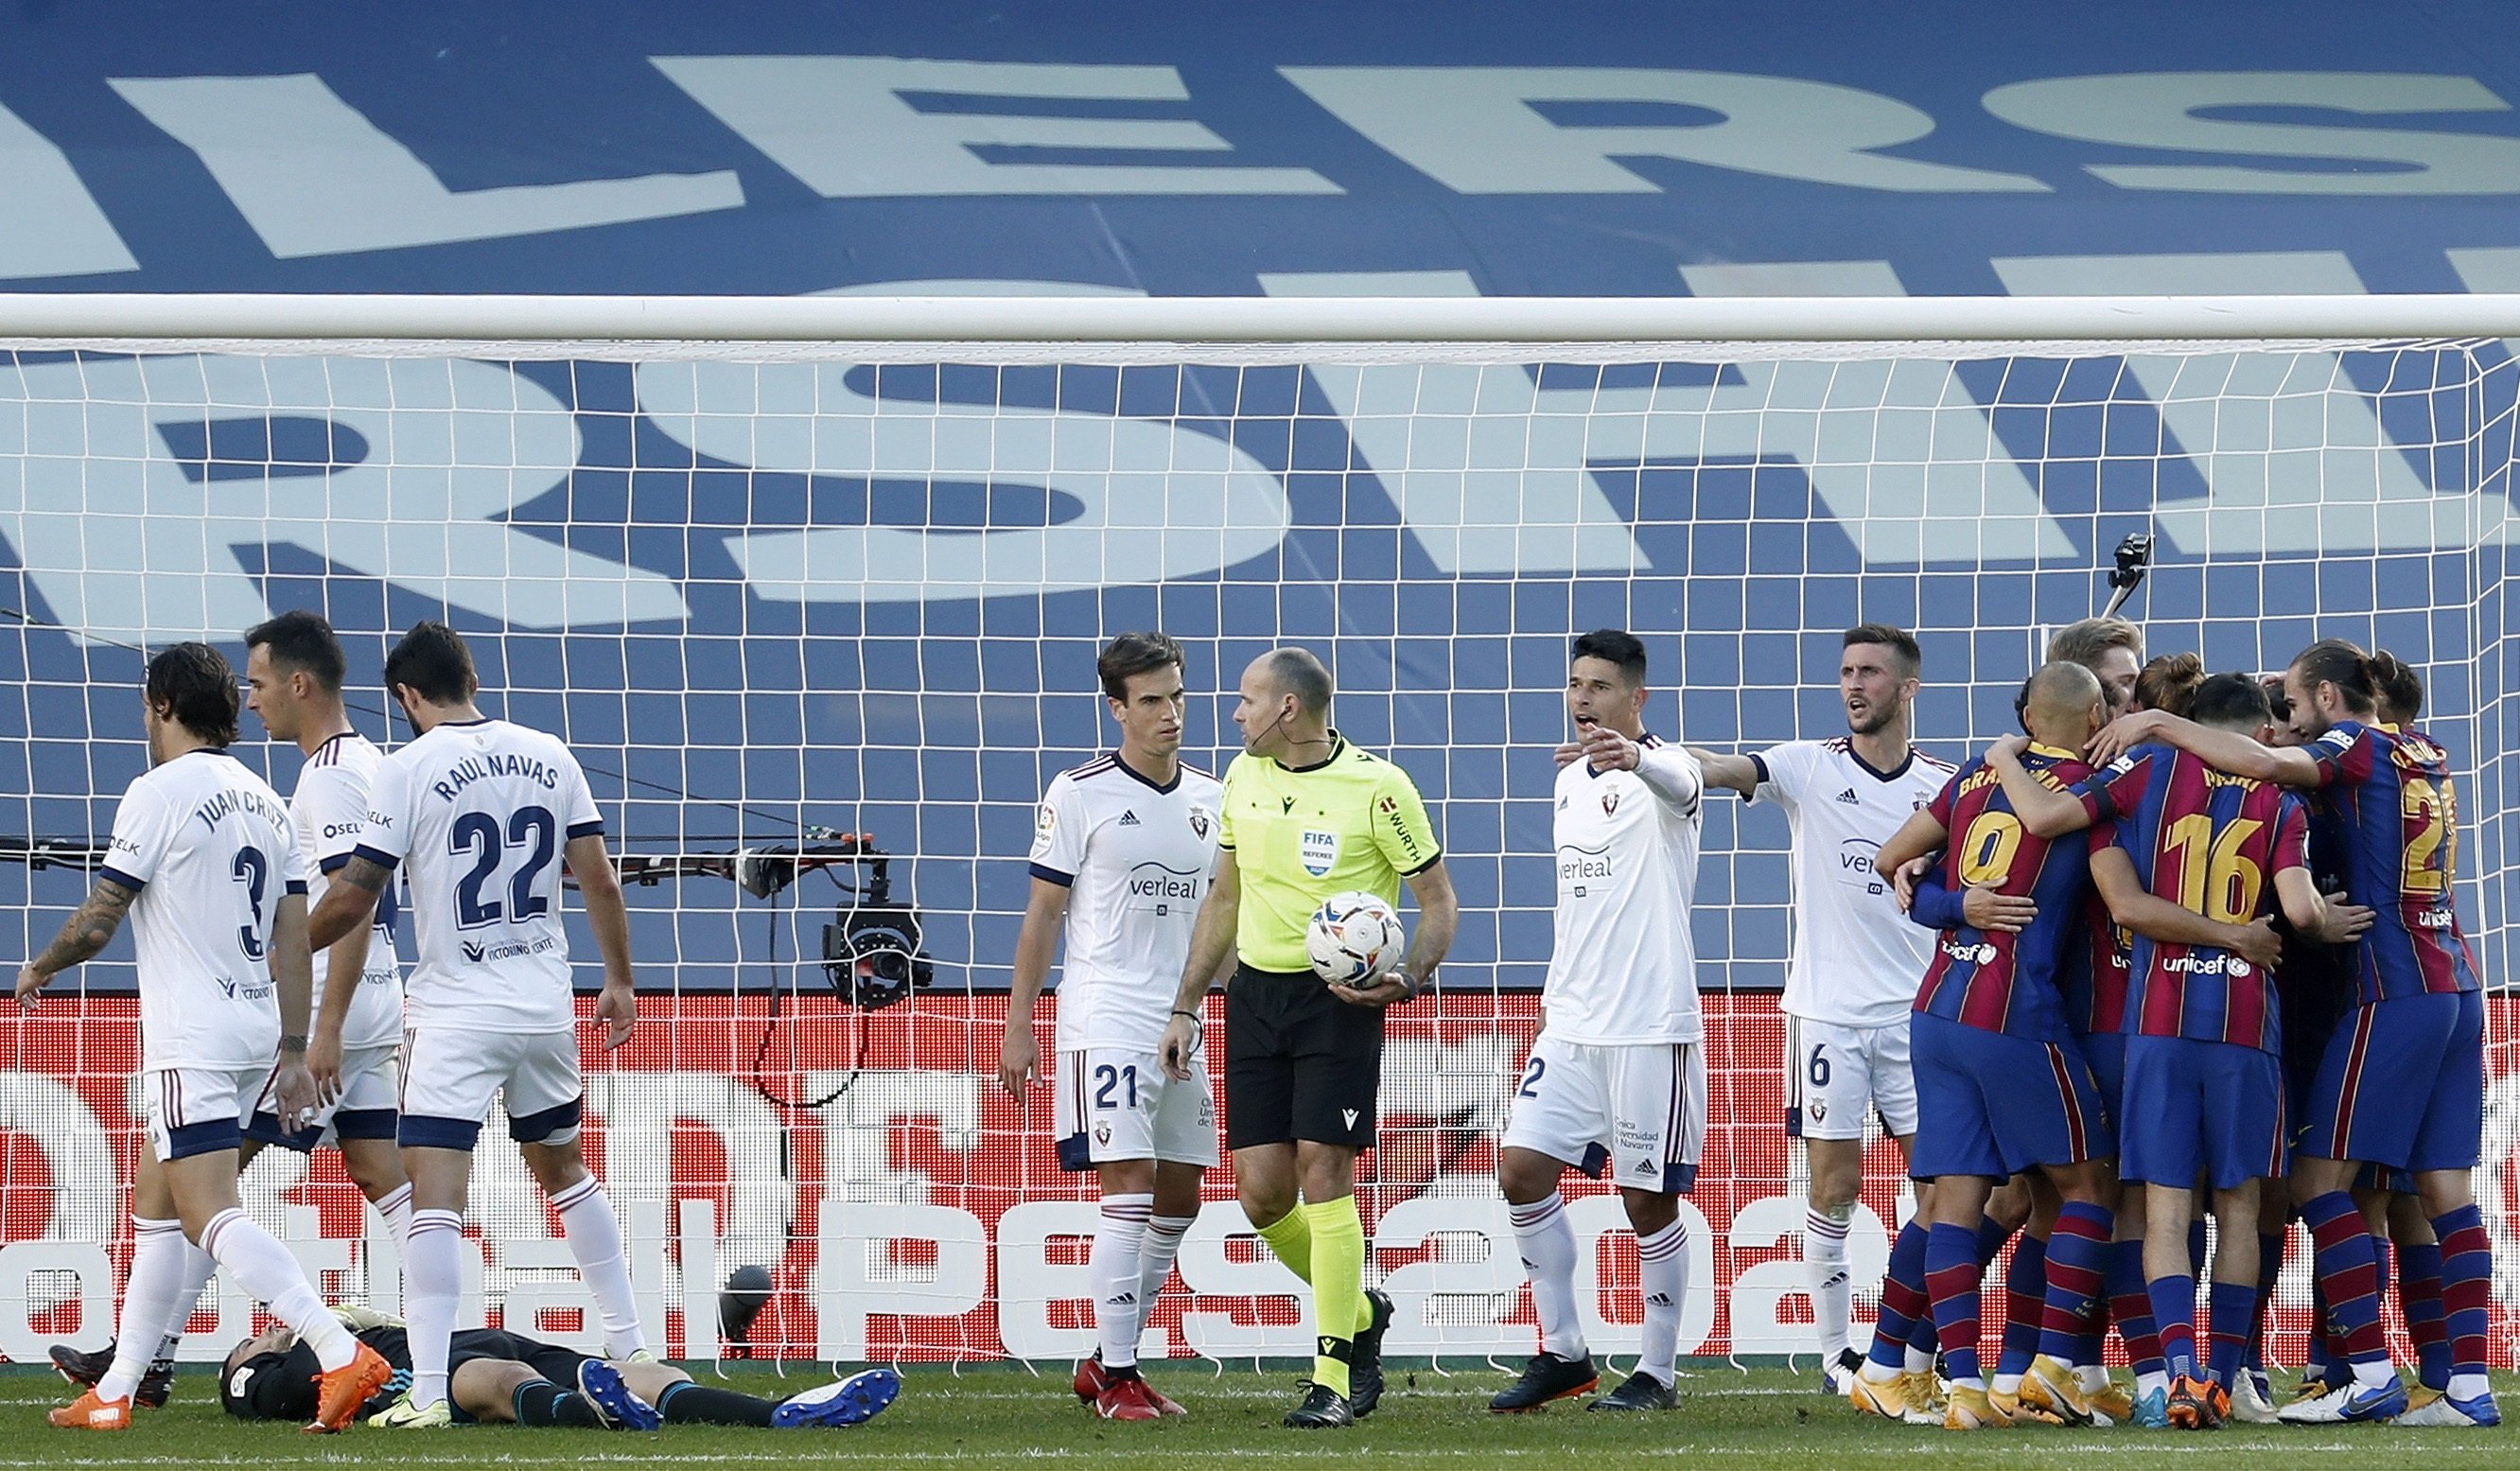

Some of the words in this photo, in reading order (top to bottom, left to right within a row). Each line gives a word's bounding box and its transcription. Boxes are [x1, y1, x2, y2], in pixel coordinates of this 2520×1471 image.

[433, 757, 487, 803] RAÚL
[487, 754, 559, 790] NAVAS
[195, 789, 241, 834] JUAN
[242, 791, 285, 835] CRUZ
[1303, 849, 1334, 860] REFEREE
[1304, 832, 1335, 846] FIFA
[1389, 812, 1422, 863] WÜRTH
[448, 805, 555, 931] 22
[1130, 876, 1198, 900] verleal
[1557, 856, 1614, 881] verleal
[2163, 813, 2264, 925] 16
[232, 845, 268, 962] 3
[2163, 953, 2227, 975] unicef
[1518, 1057, 1546, 1099] 2
[1809, 1042, 1830, 1087] 6
[1094, 1063, 1137, 1112] 21
